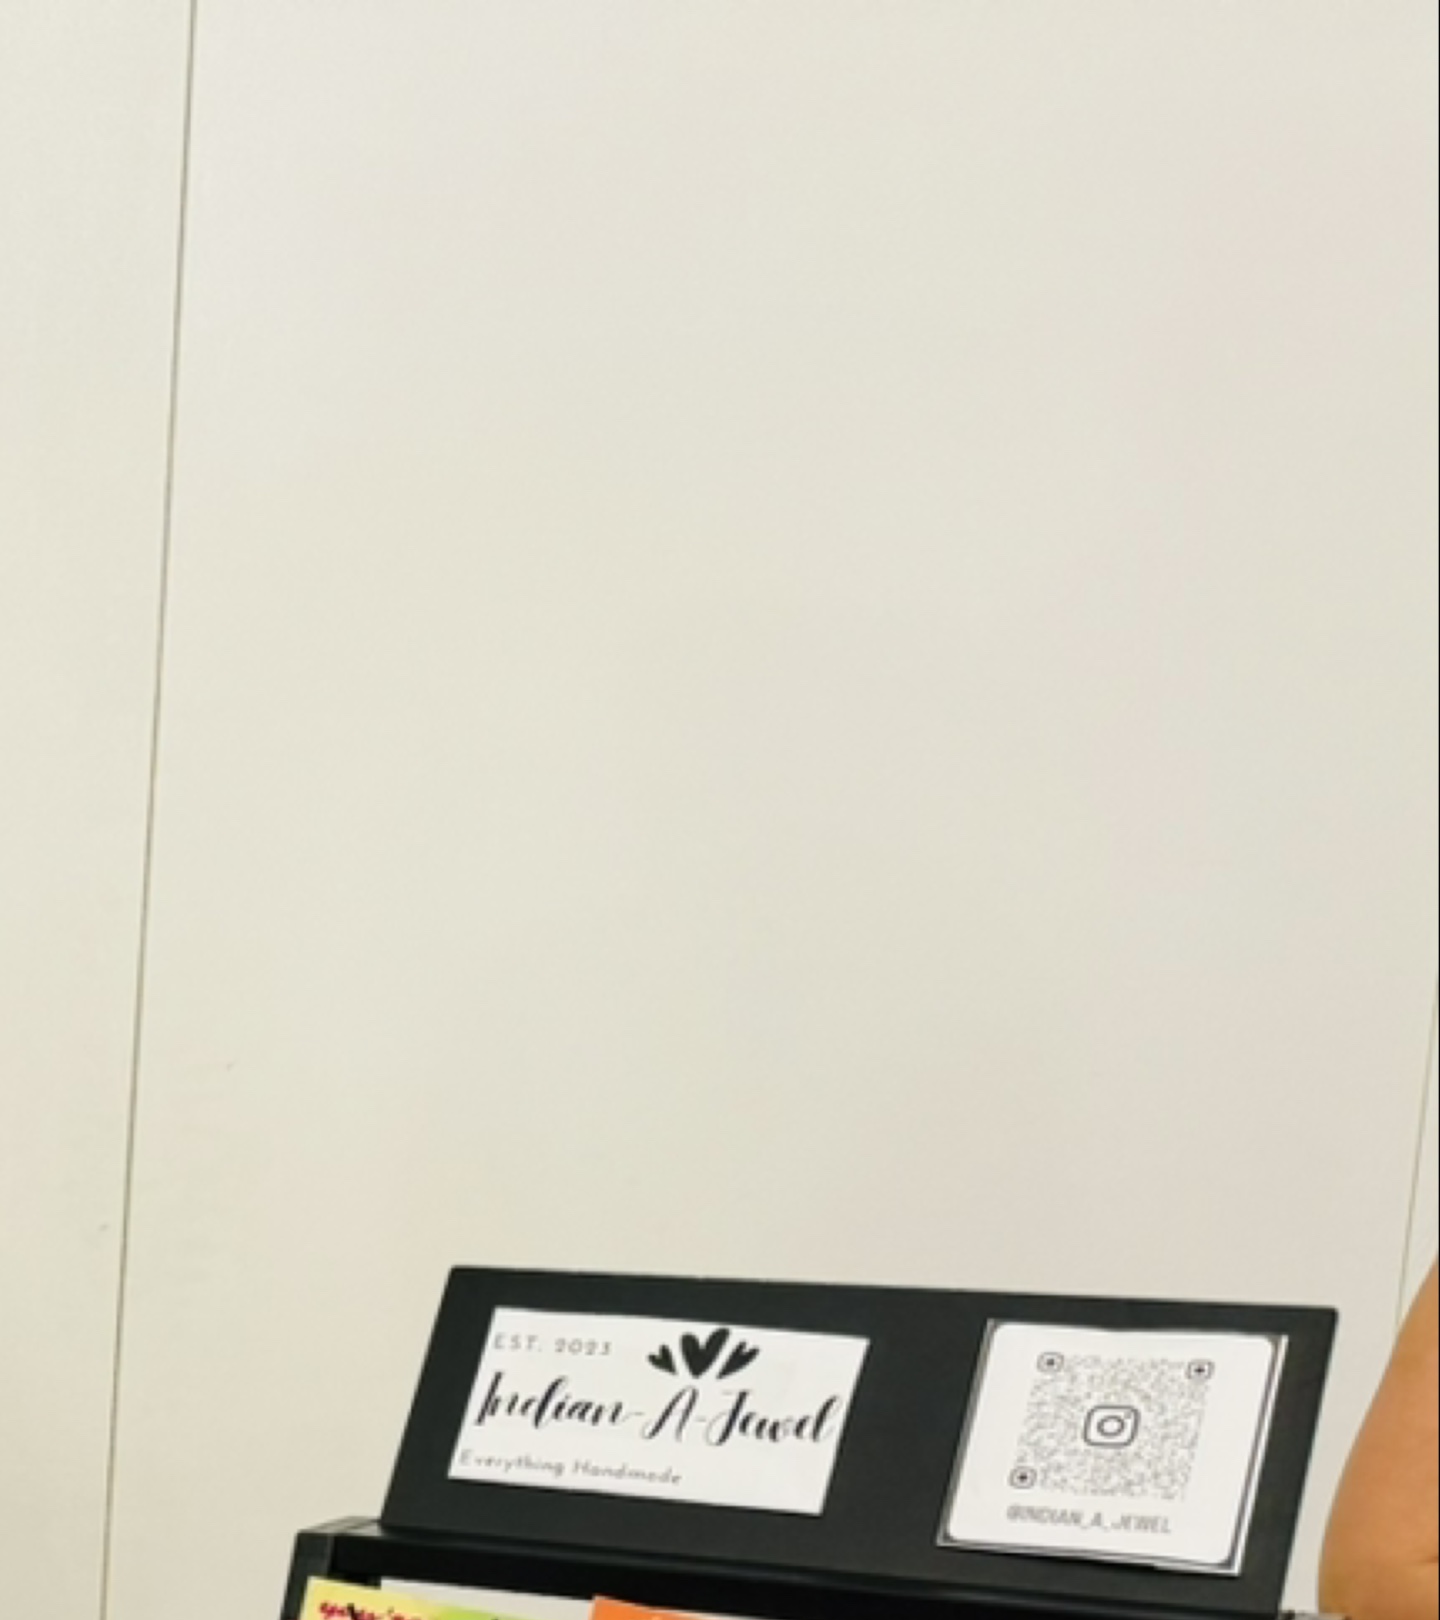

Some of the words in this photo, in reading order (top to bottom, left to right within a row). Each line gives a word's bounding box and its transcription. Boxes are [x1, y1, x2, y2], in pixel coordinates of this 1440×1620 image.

[494, 1334, 542, 1353] EST.
[554, 1337, 613, 1356] 2023
[475, 1371, 843, 1447] Indian-A-Jewel
[460, 1448, 565, 1479] Everything
[572, 1458, 683, 1486] Handmade
